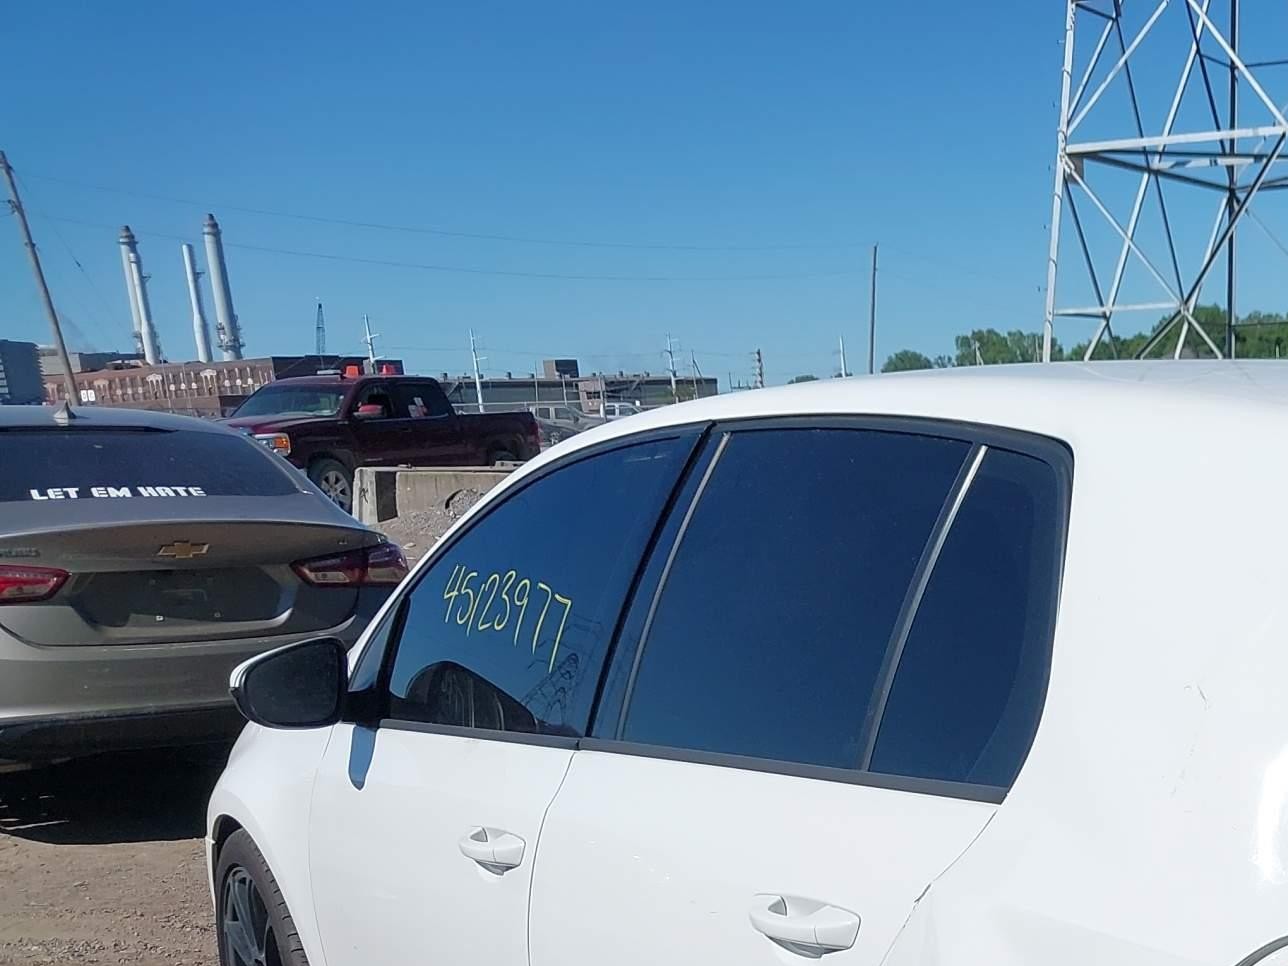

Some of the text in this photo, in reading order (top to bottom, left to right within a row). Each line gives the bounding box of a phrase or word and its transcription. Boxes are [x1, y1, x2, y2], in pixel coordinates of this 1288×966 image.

[29, 486, 207, 500] LET EM HATE
[443, 563, 572, 674] 45123977
